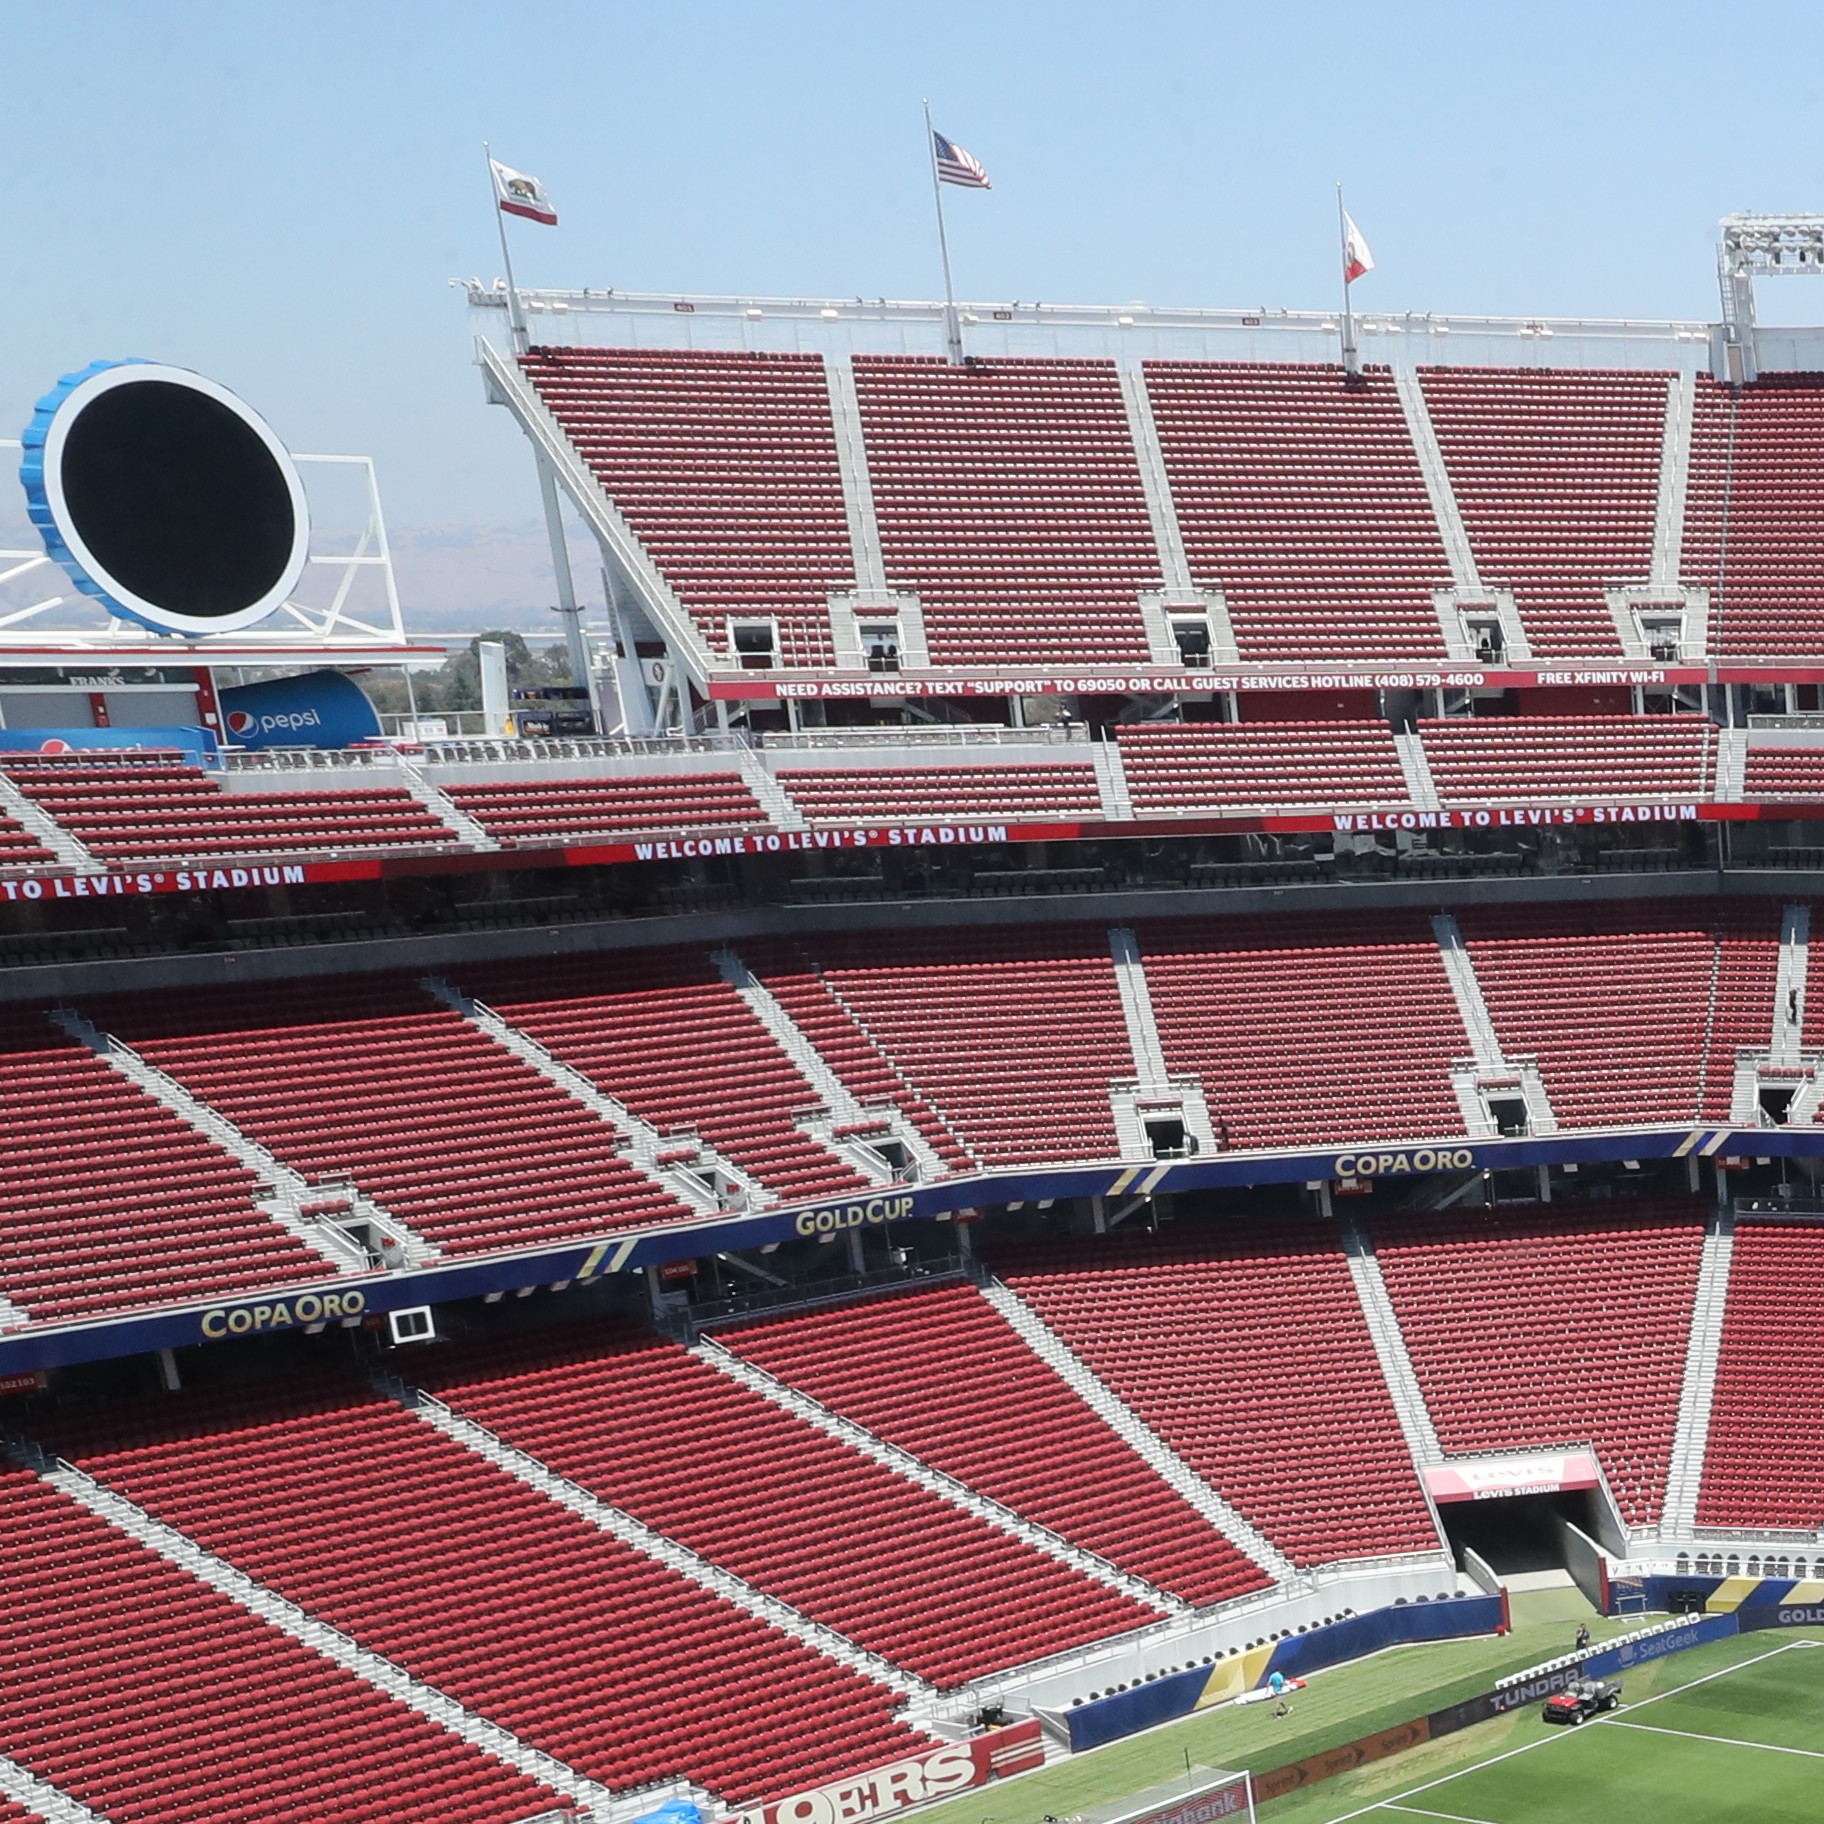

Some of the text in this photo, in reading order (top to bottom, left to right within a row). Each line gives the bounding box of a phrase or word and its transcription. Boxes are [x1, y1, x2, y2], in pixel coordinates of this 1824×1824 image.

[775, 683, 817, 697] NEED
[821, 682, 922, 696] ASSISTANCE?
[925, 681, 964, 694] TEXT
[1054, 679, 1074, 692] TO
[1077, 678, 1126, 691] 69050
[1129, 678, 1148, 690] OR
[1153, 677, 1190, 690] CALL
[1192, 676, 1239, 690] GUEST
[1241, 676, 1309, 689] SERVICES
[1311, 675, 1373, 688] HOTLINE
[1375, 674, 1414, 688] (408)
[1415, 673, 1484, 687] 579-4600
[1537, 671, 1665, 684] FREE XFINITY WI-FI
[261, 708, 321, 733] pepsi
[1333, 812, 1451, 829] WELCOME
[1460, 811, 1491, 826] TO
[1593, 805, 1697, 822] STADIUM
[635, 835, 746, 860] WELCOME
[753, 834, 781, 852] TO
[889, 825, 1007, 846] STADIUM
[2, 879, 43, 901] TO
[176, 865, 306, 891] STADIUM
[1334, 1149, 1473, 1177] COPA ORO
[796, 1197, 914, 1235] GOLD CUP
[201, 1291, 365, 1338] COPA ORO
[1514, 1483, 1560, 1496] STADIUM
[1639, 1628, 1700, 1658] SeatGeek
[1489, 1667, 1580, 1710] TUNDRA
